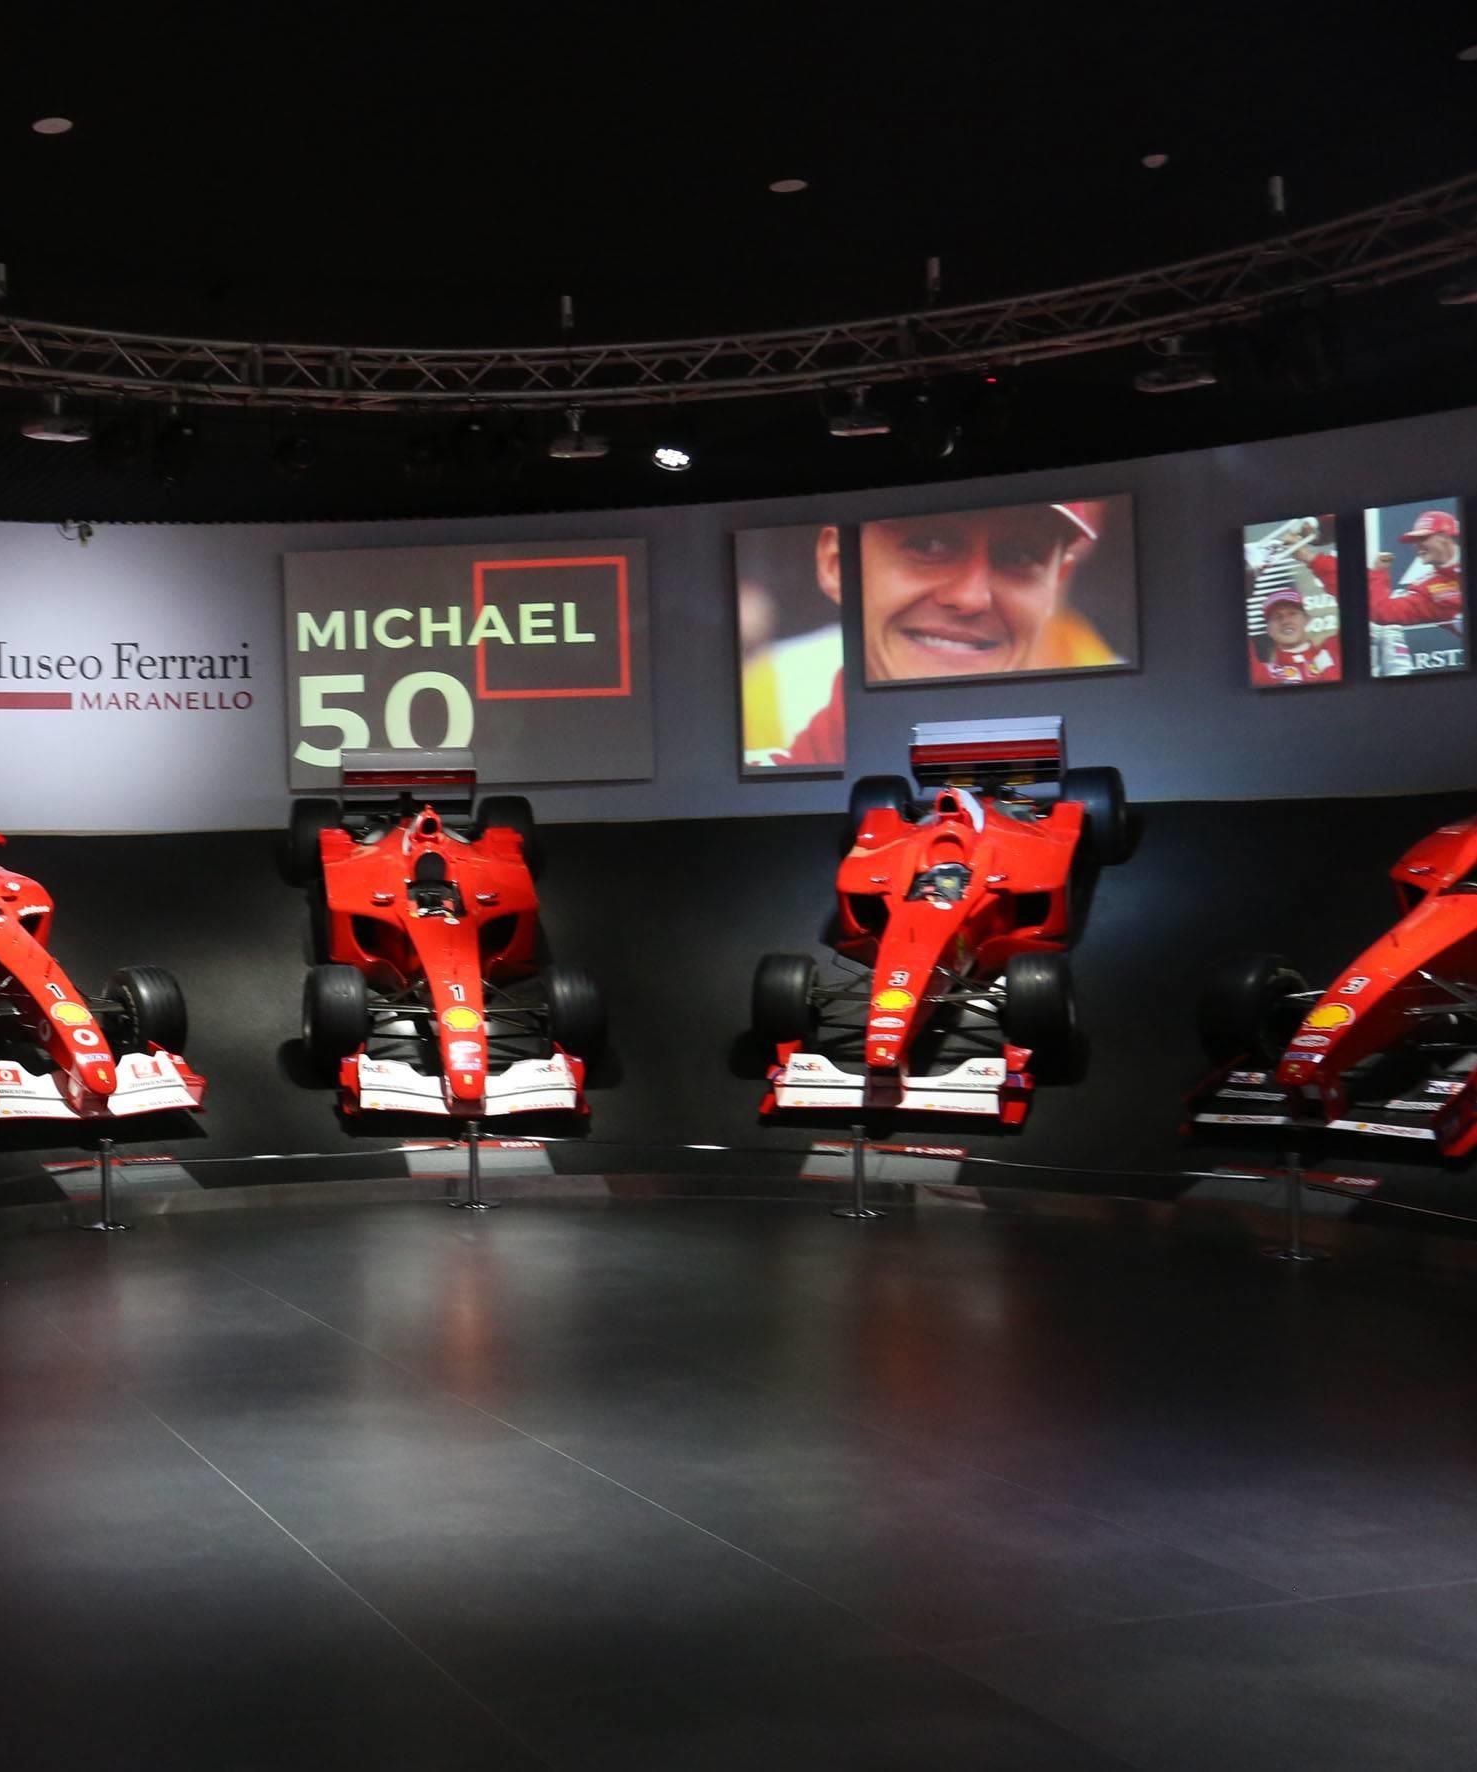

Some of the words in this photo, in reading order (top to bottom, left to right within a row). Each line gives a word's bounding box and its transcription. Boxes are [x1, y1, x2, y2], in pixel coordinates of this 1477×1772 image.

[297, 601, 597, 653] MICHAEL
[111, 640, 253, 680] Ferrari
[79, 690, 254, 711] MARANELLO
[293, 671, 474, 767] 50
[44, 982, 67, 1001] 1
[448, 983, 466, 1002] 1
